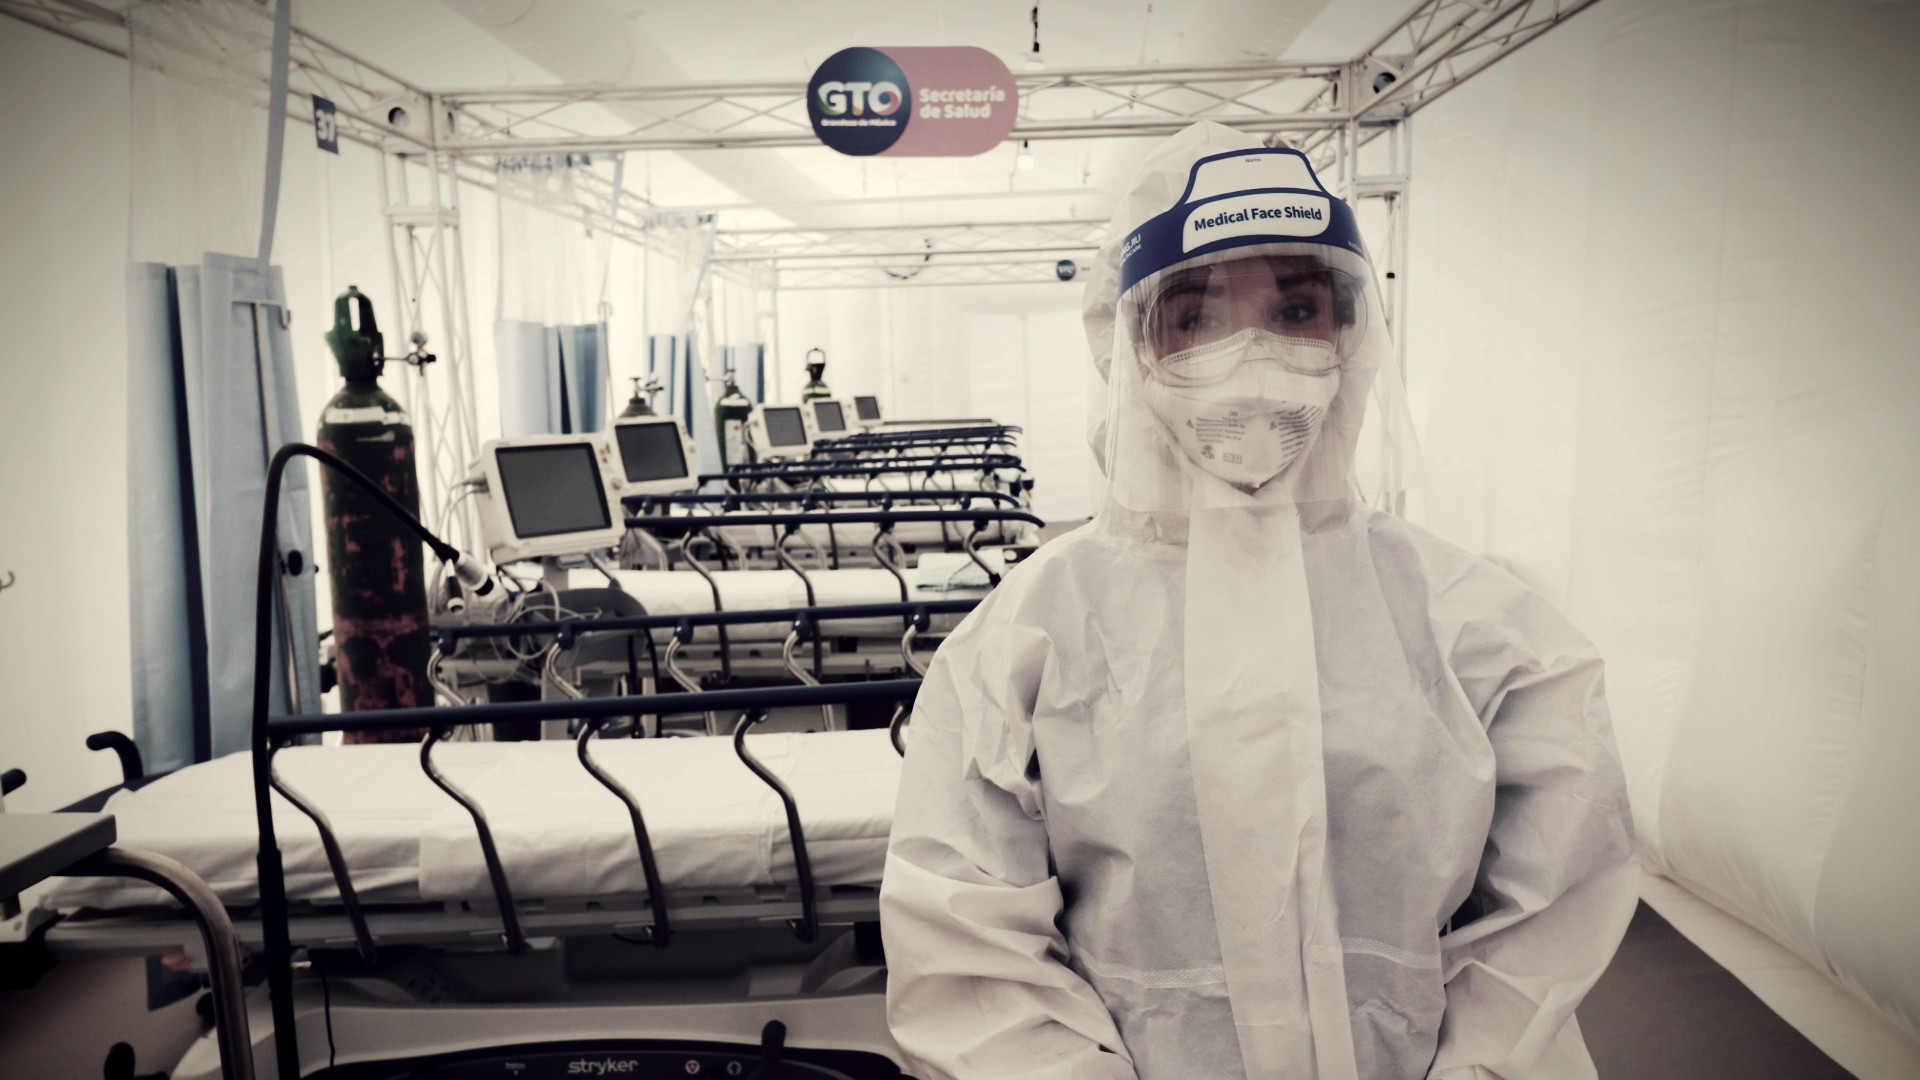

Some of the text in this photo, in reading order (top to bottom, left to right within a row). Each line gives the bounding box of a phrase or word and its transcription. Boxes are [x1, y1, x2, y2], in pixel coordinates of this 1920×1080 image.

[817, 81, 902, 116] GTO
[919, 85, 1006, 102] Secretaría
[919, 103, 991, 118] de Salud
[1194, 206, 1323, 231] Medical Face Shield
[567, 1057, 639, 1075] stryker
